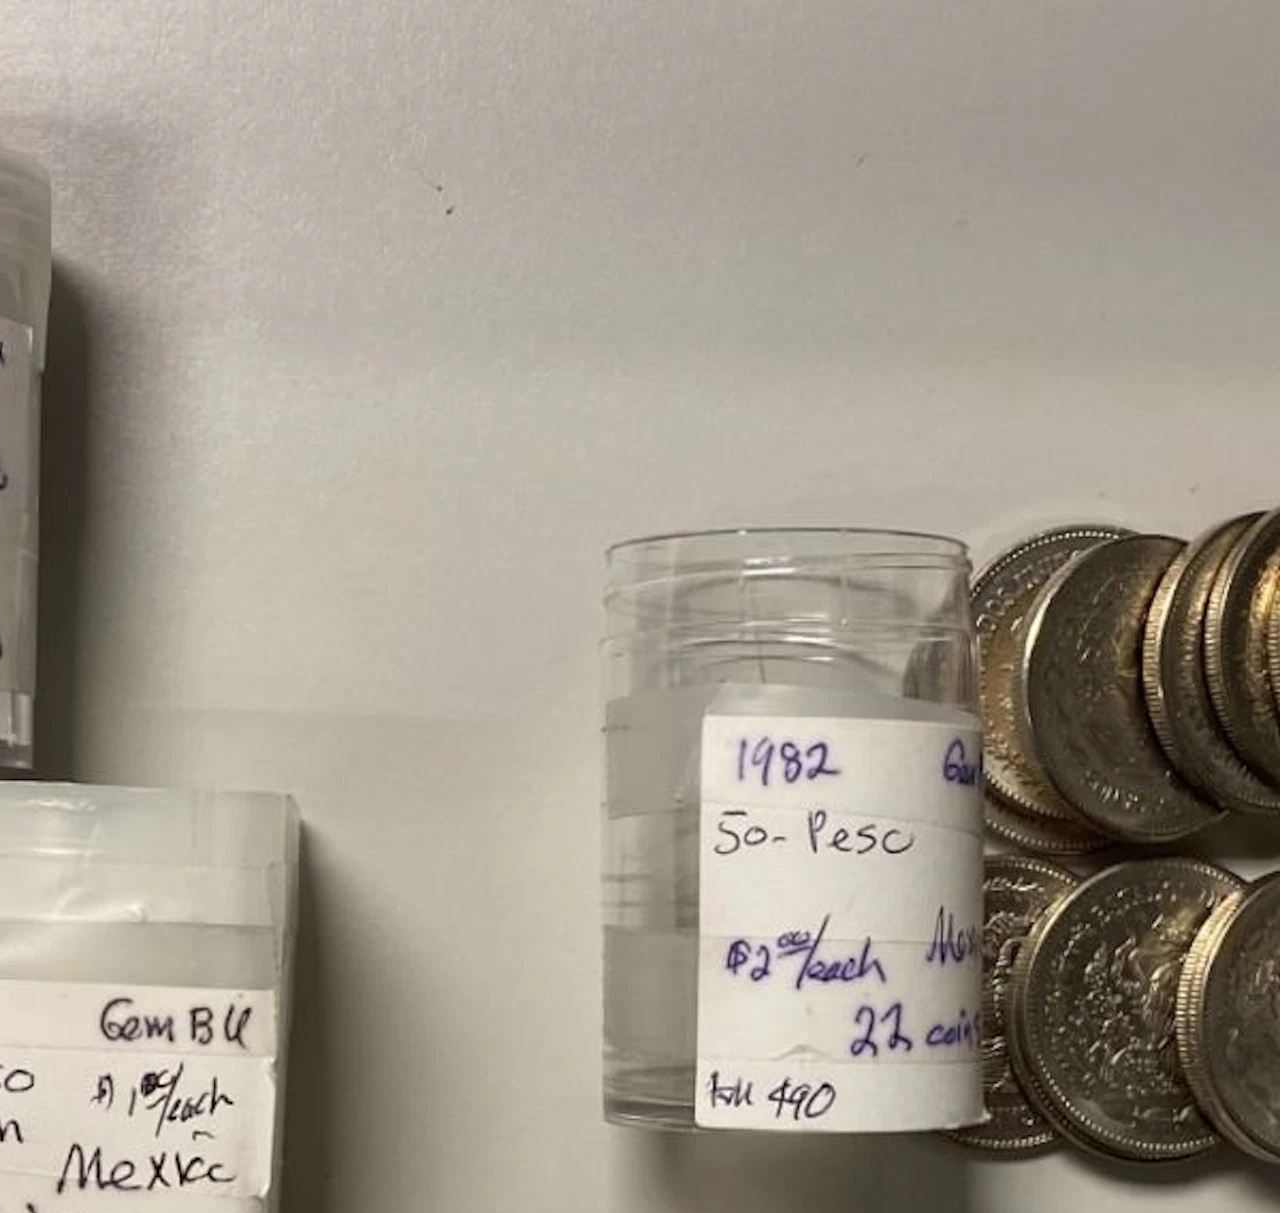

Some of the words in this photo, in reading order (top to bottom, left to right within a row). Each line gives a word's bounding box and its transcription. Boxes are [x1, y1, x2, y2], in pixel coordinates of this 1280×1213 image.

[737, 738, 840, 786] 1982
[808, 811, 916, 854] Peso
[100, 997, 174, 1042] Gem
[850, 1003, 912, 1058] 22
[768, 1081, 835, 1120] 490
[56, 1142, 236, 1193] Mexico
